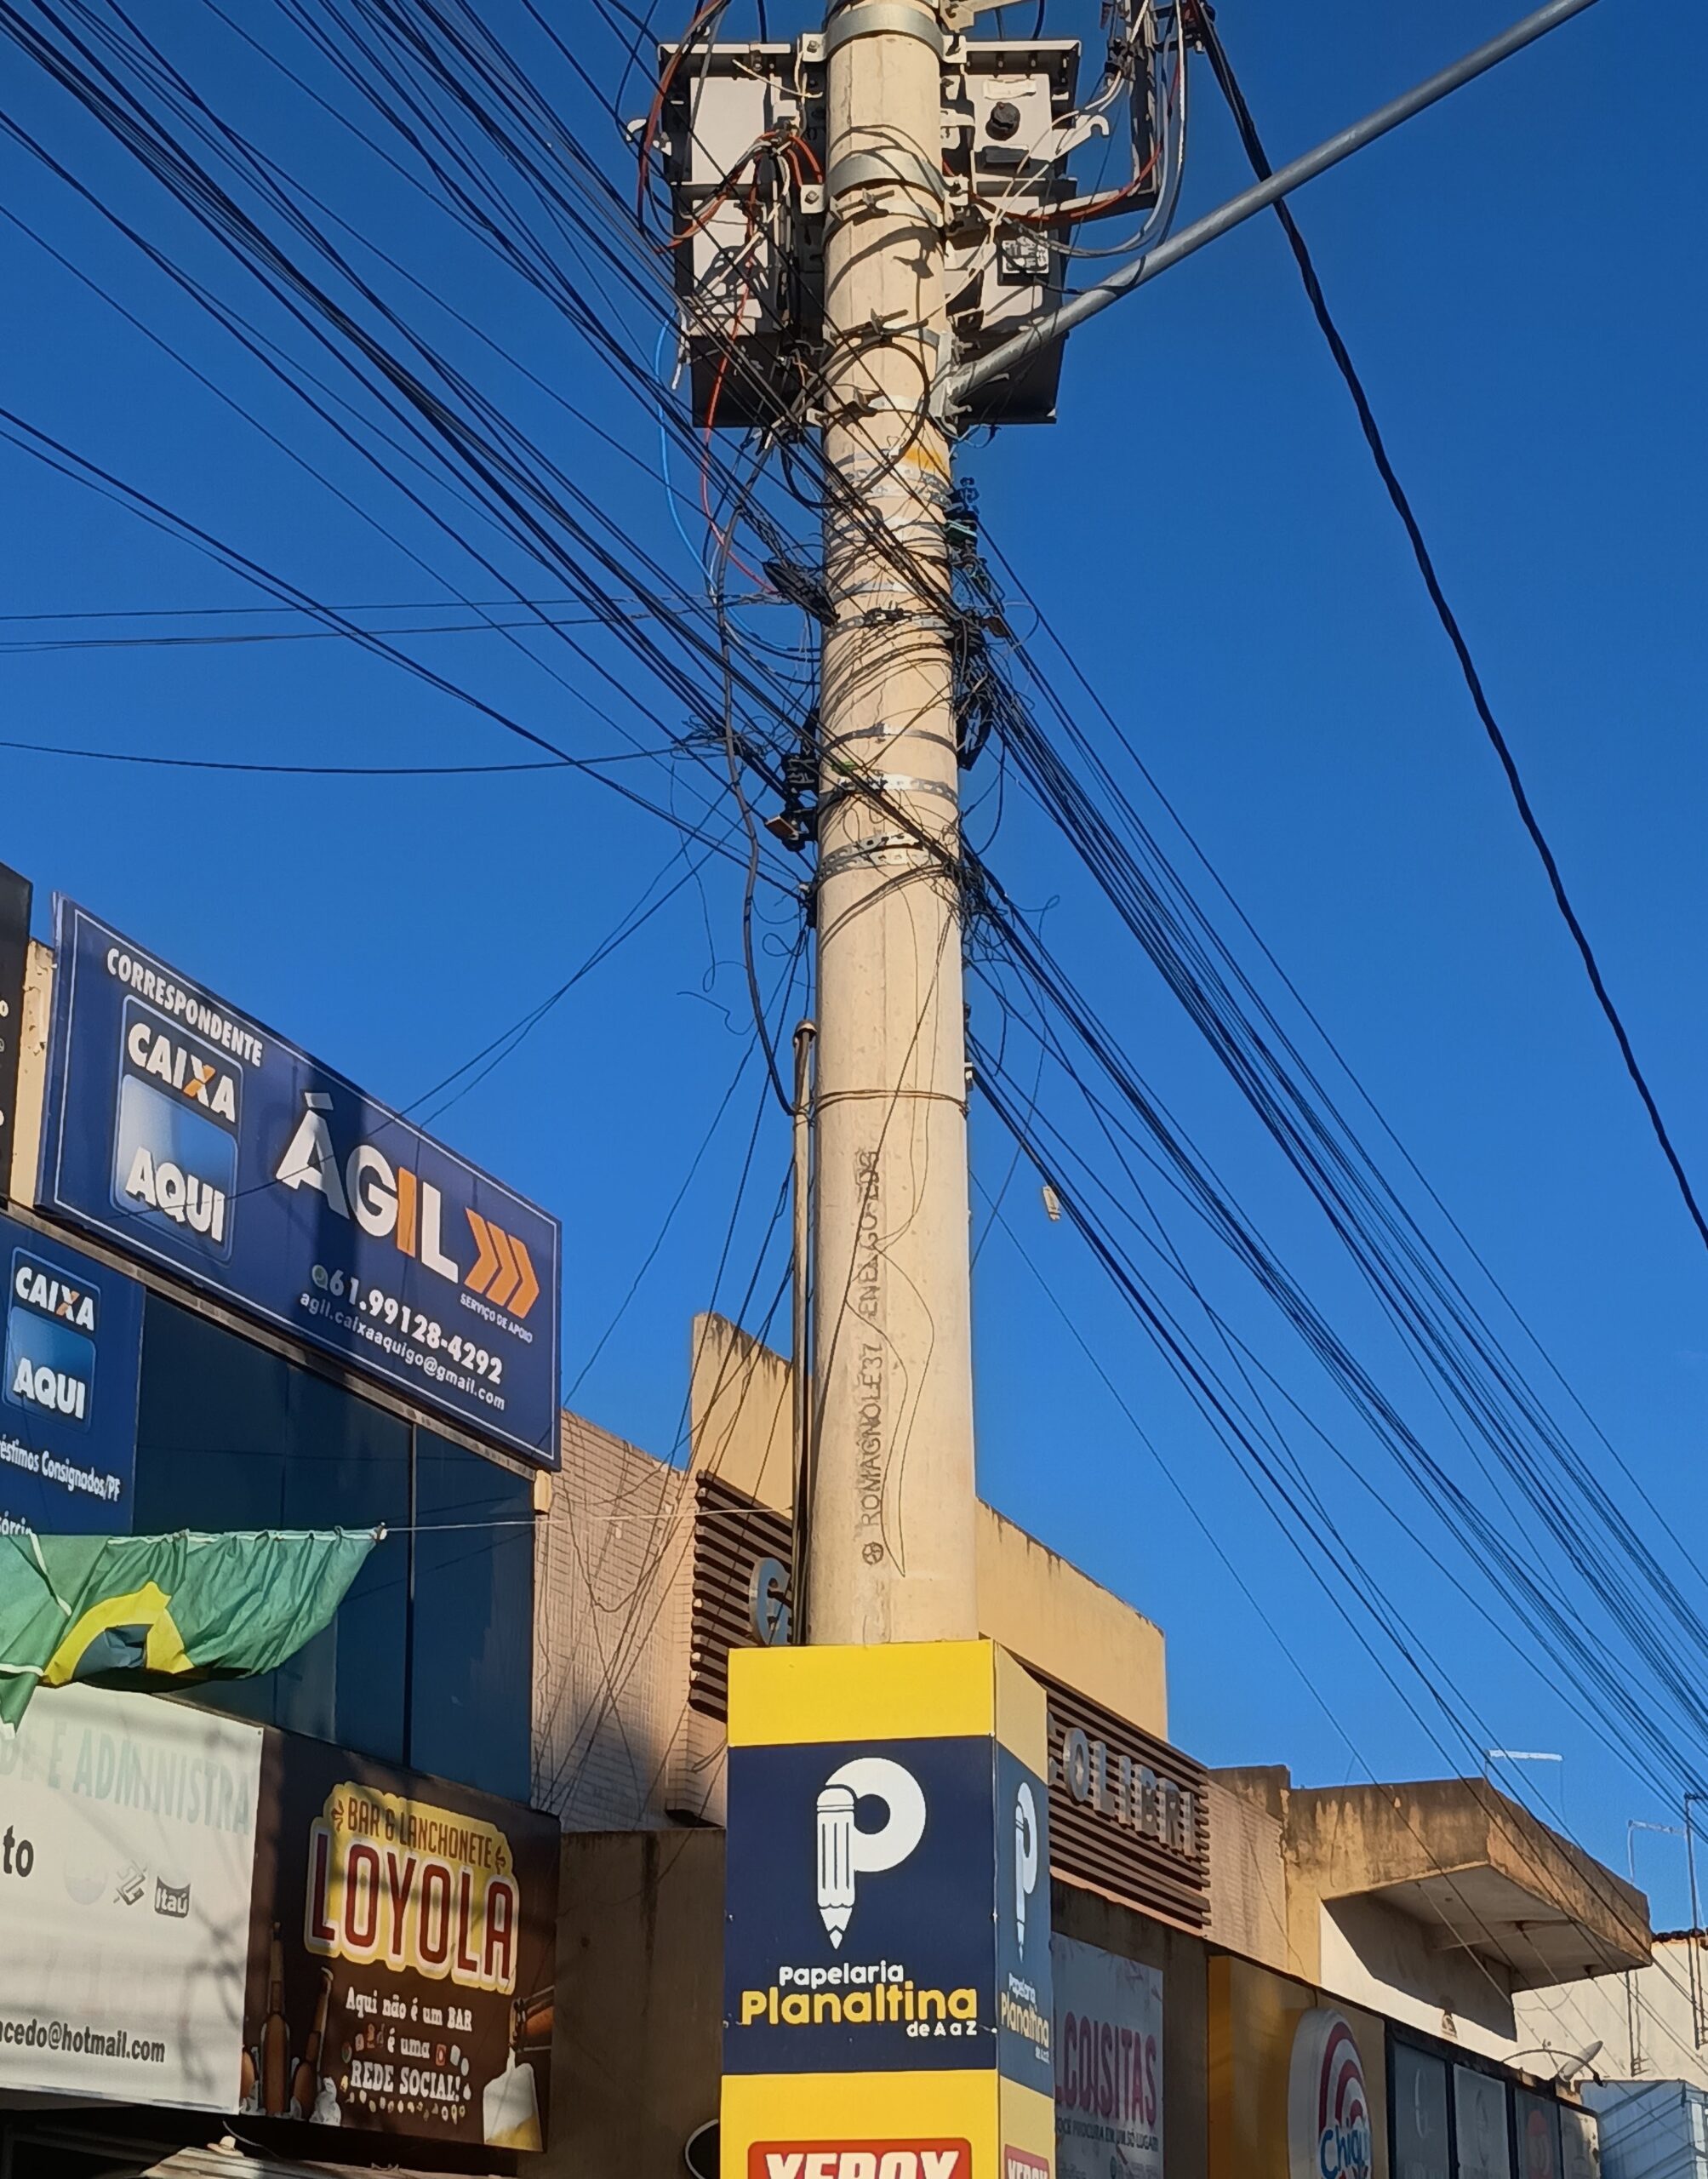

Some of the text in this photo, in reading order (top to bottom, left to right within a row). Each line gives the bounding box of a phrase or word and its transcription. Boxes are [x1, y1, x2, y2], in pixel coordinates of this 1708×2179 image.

[107, 947, 263, 1067] CORRESPONDENTE
[129, 1022, 236, 1124] CAIXA
[125, 1147, 226, 1243] AQUI
[14, 1266, 94, 1332] CAIXA
[329, 1269, 503, 1385] 61.99128-4292
[460, 1292, 534, 1343] SERVIÇO DE APOIO
[300, 1292, 506, 1411] agil.caixaaquigo@gmail.com
[13, 1357, 86, 1421] AQUI
[0, 1433, 121, 1502] éstimos Consignados/PF
[71, 1728, 250, 1835] ADMINISTRA
[1048, 1711, 1198, 1859] OLIBRI
[347, 1796, 380, 1838] BAR
[399, 1810, 493, 1870] LANCHONETE
[156, 1886, 189, 1915] Itaú
[310, 1831, 514, 1982] LOYOLA
[741, 1980, 978, 2026] Planaltina
[779, 1959, 904, 1990] Papelaria
[345, 1986, 472, 2033] Aqui não é um BAR
[387, 2027, 431, 2060] é uma
[906, 2020, 978, 2038] de A a Z
[350, 2059, 461, 2103] REDE SOCIAL!
[1055, 2010, 1157, 2127] COISITAS
